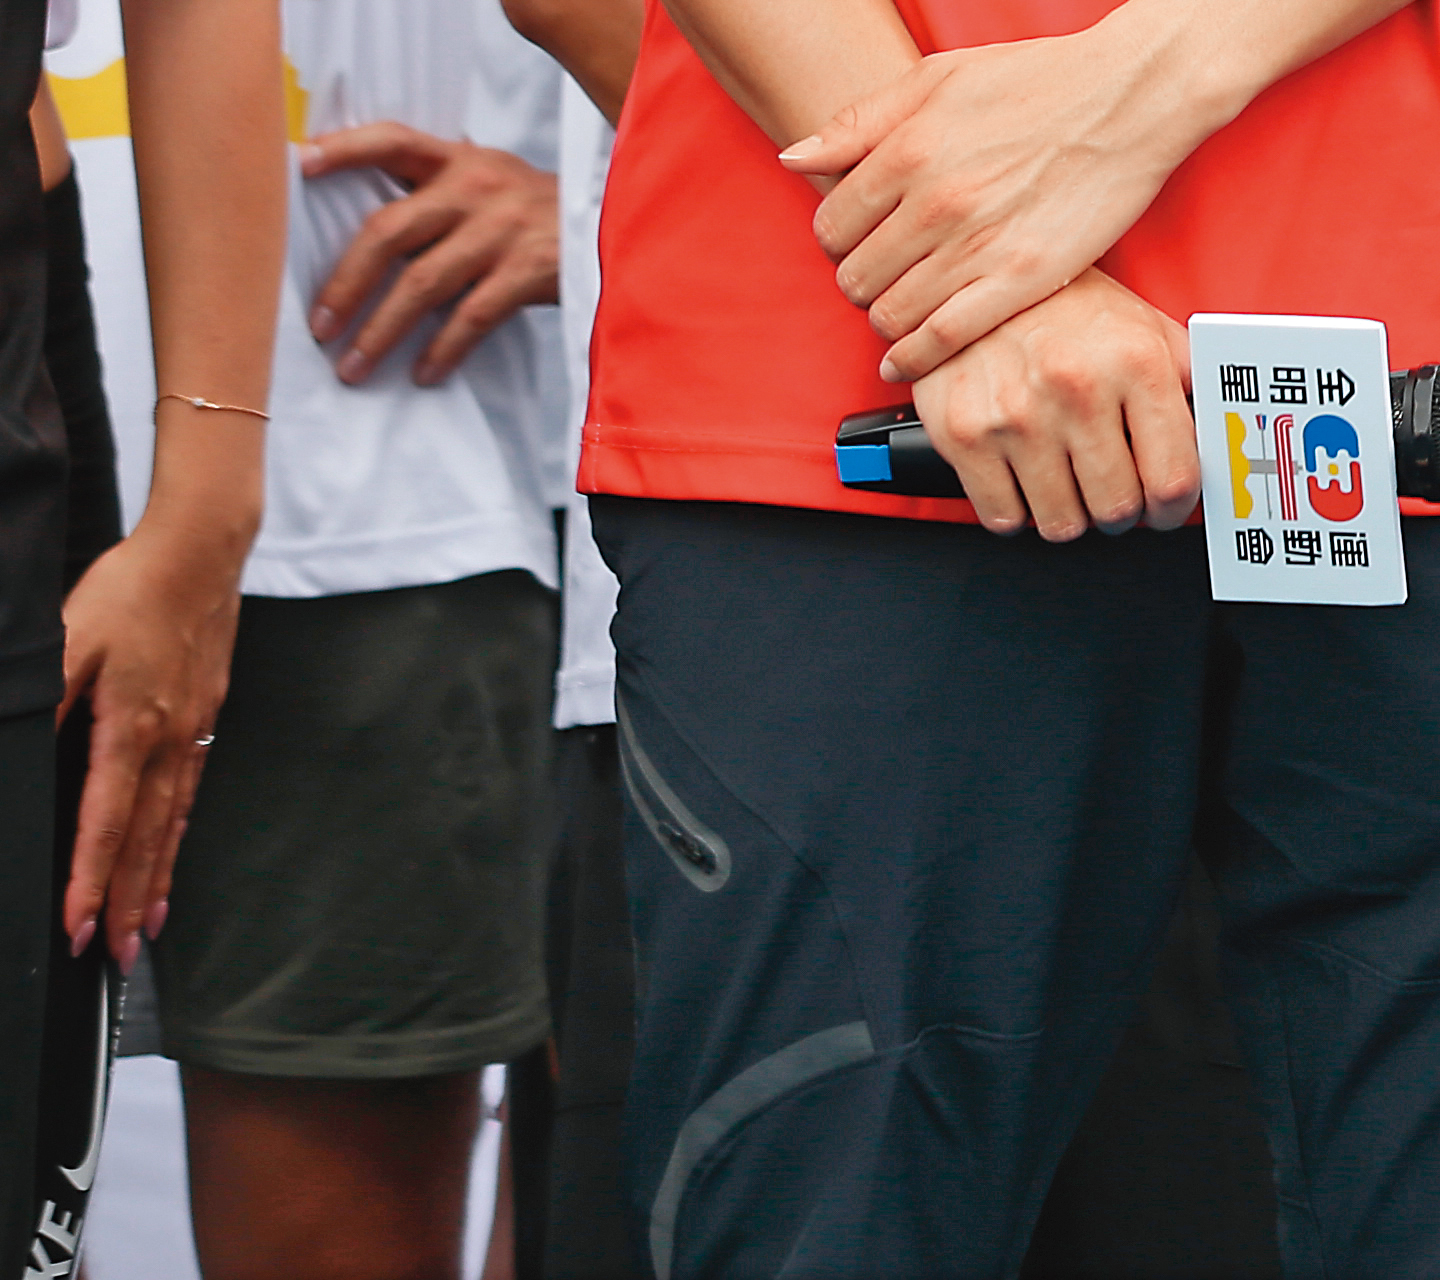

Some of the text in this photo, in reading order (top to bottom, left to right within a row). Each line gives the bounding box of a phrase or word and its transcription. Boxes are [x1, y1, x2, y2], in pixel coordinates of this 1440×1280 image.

[1220, 364, 1355, 406] 全明星
[1235, 527, 1369, 567] 運動會
[22, 1199, 84, 1280] KE
